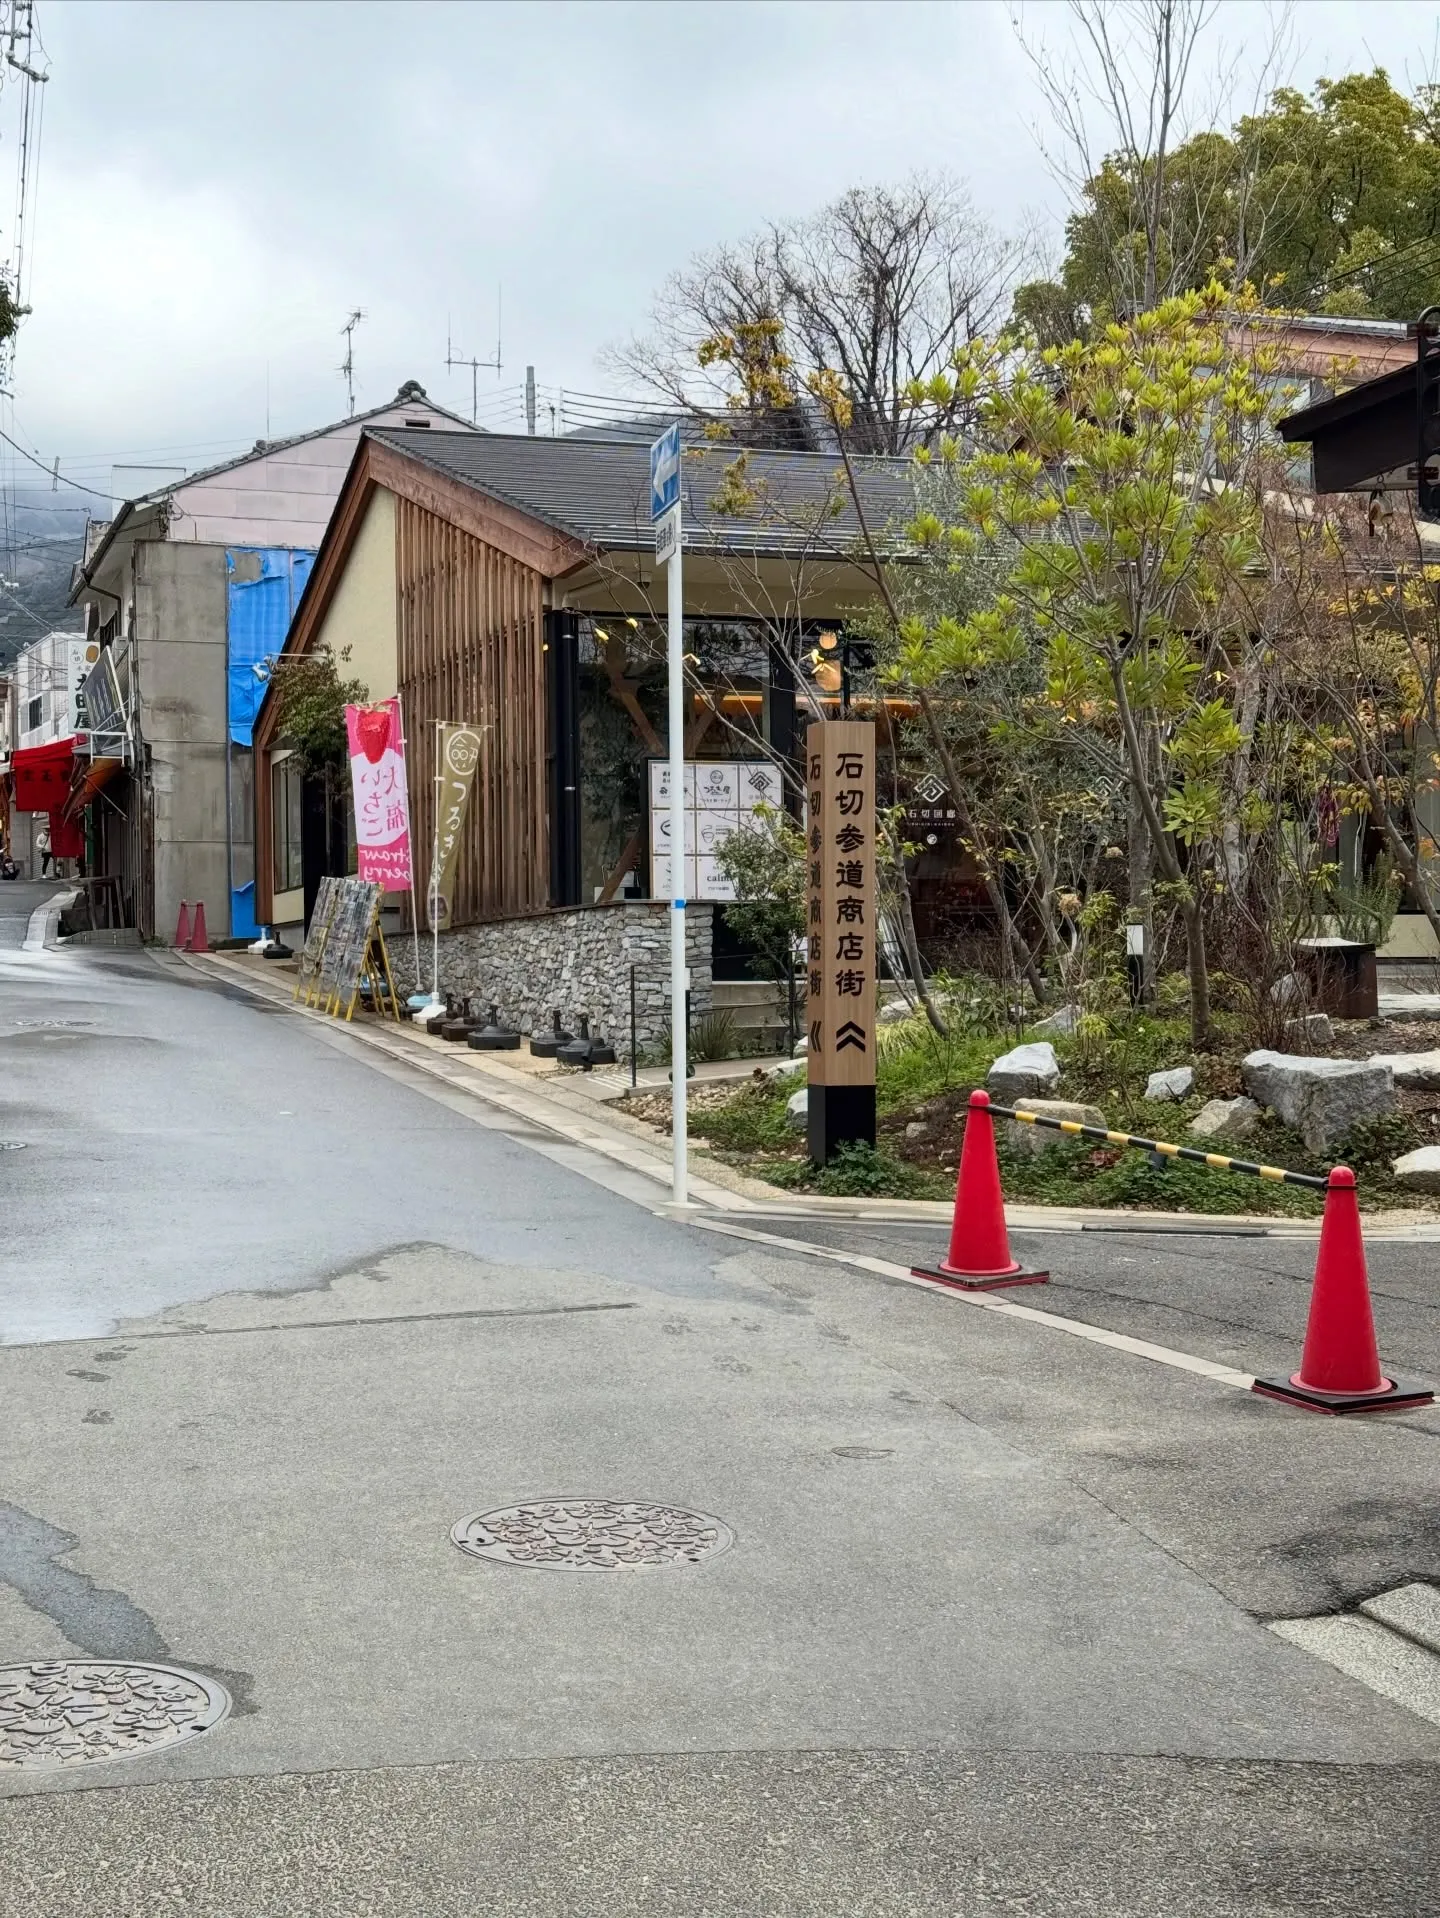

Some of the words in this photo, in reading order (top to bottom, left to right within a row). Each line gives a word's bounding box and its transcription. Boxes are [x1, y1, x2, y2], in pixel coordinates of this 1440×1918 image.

[810, 752, 822, 997] 石切参道商店街
[835, 752, 866, 997] 石切参道商店街
[909, 809, 956, 819] 石切回廊
